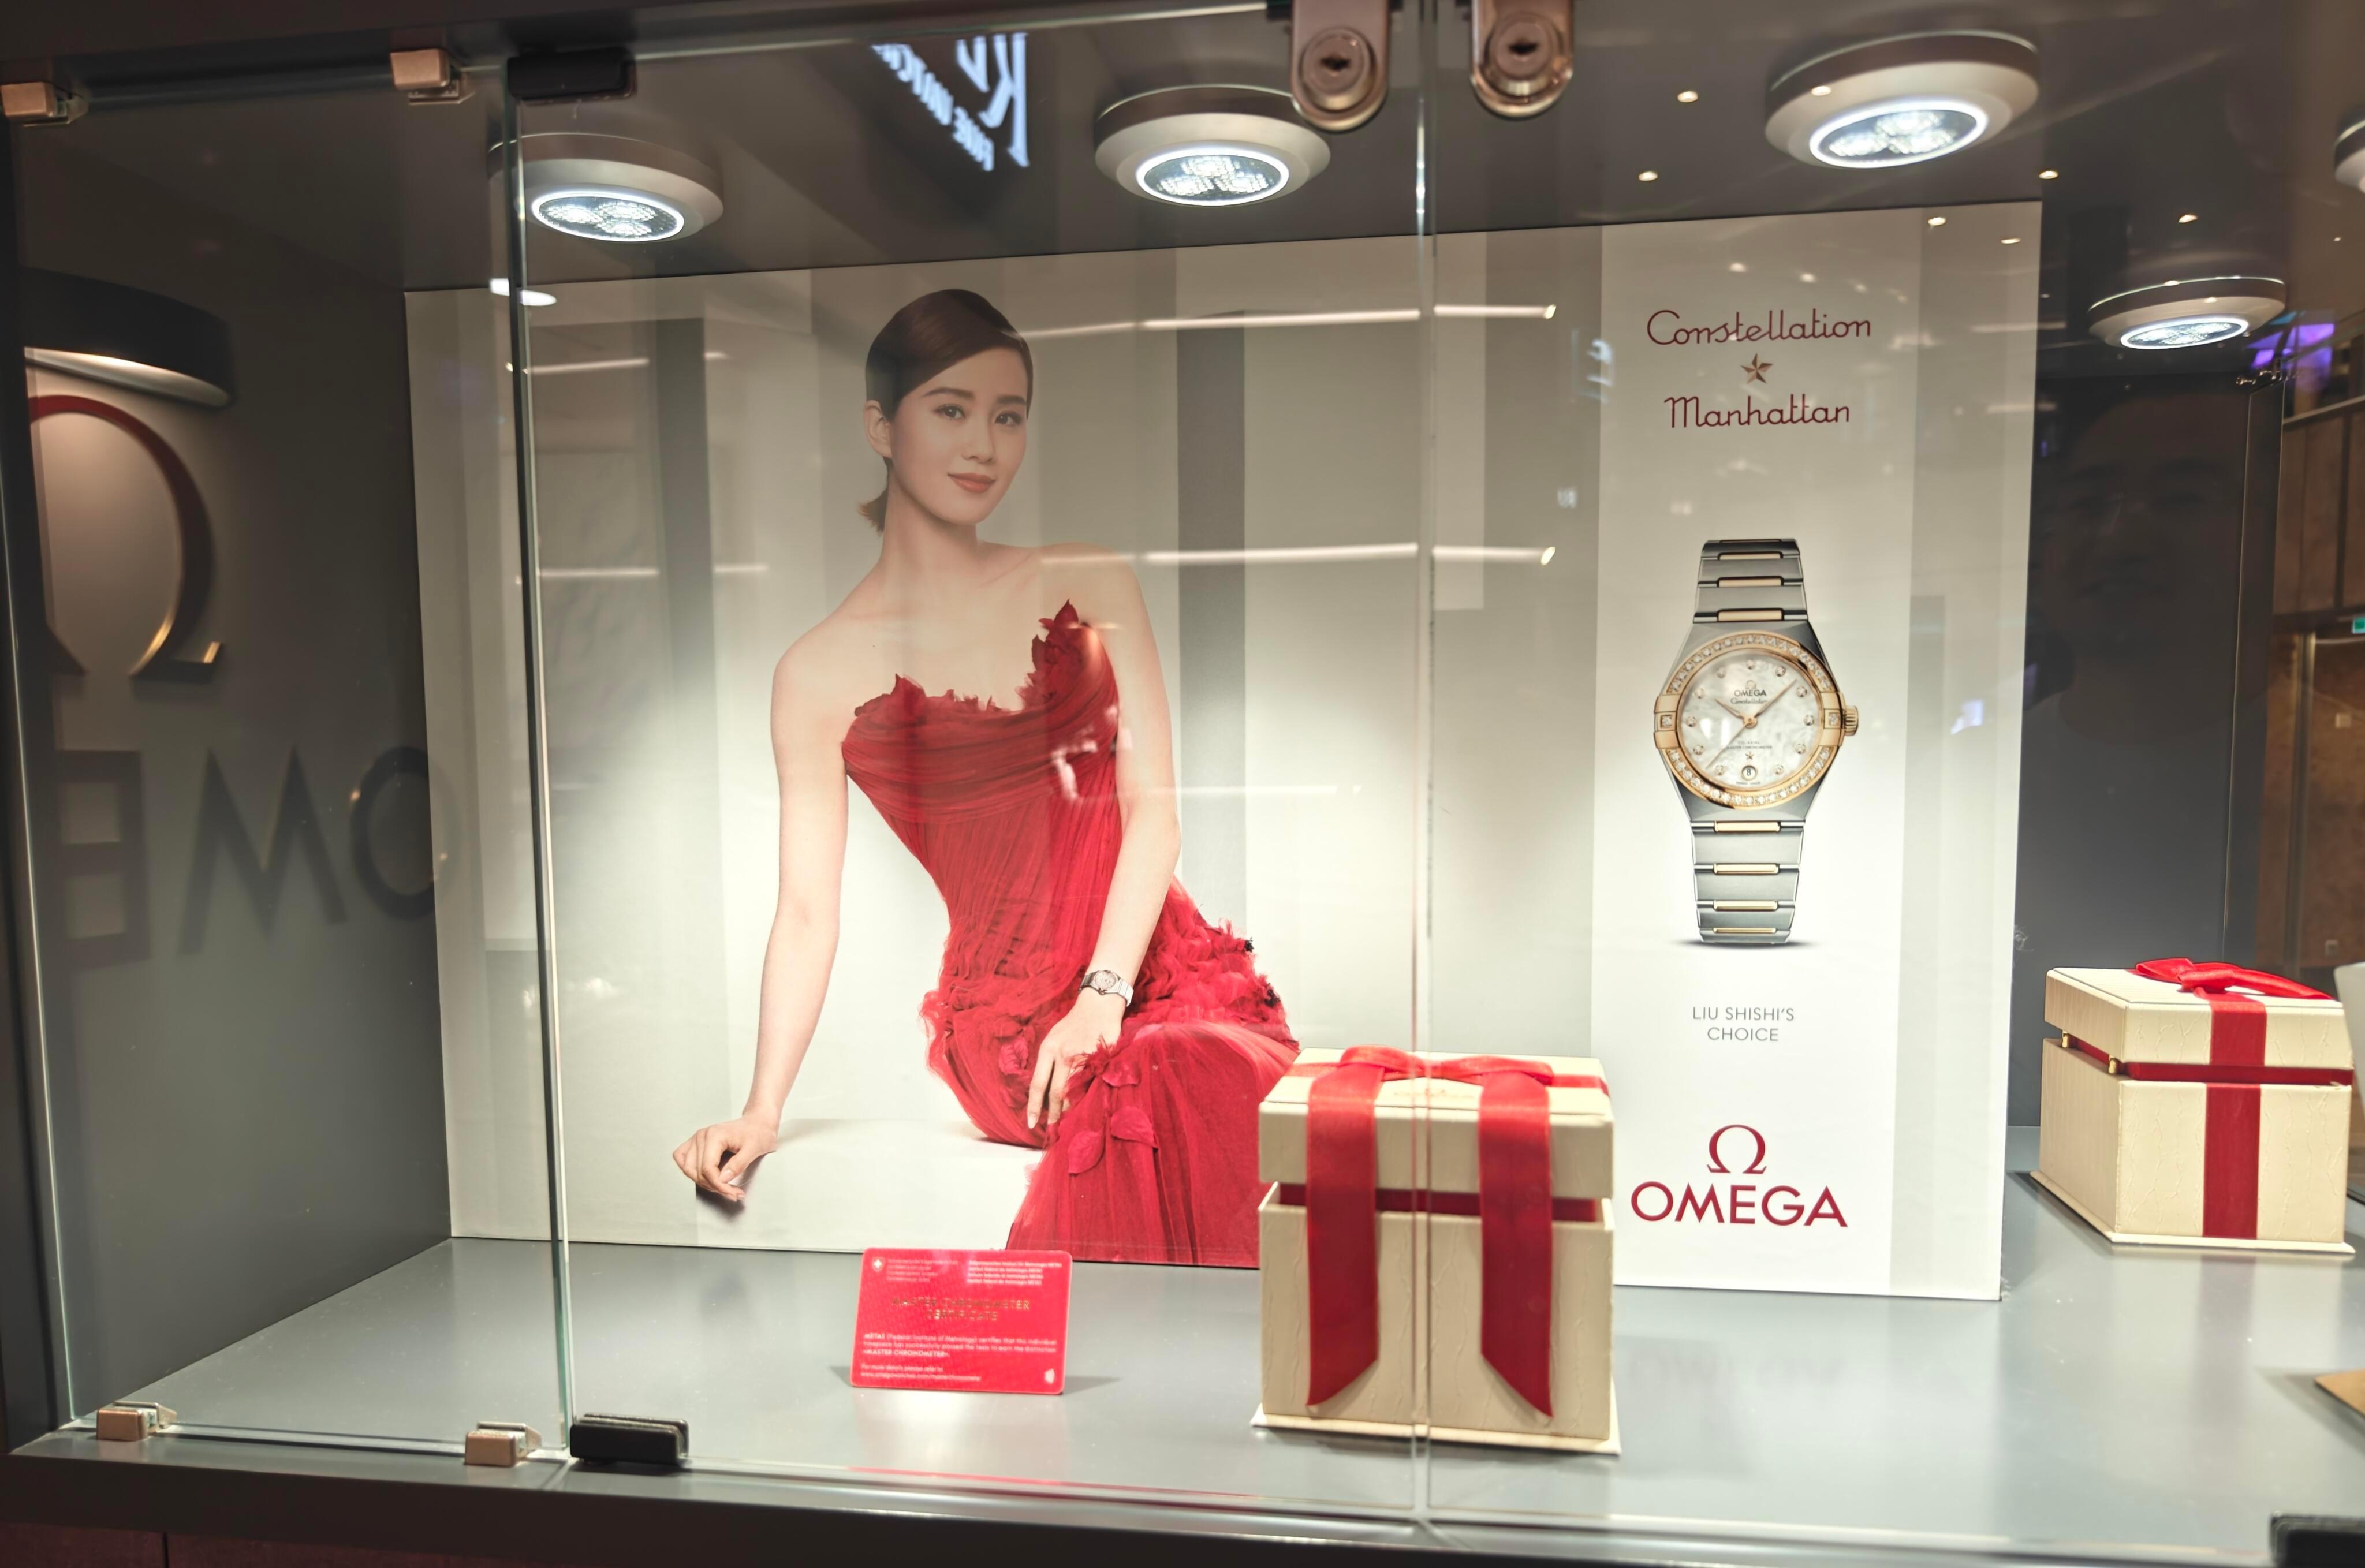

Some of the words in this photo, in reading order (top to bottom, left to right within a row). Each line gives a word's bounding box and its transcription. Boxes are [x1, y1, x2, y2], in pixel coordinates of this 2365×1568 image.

[1647, 308, 1870, 345] Constellation
[1664, 393, 1849, 428] Manhattan
[1746, 768, 1751, 776] 8
[1692, 1006, 1718, 1020] LIU
[1725, 1007, 1795, 1021] SHISHI'S
[1707, 1027, 1778, 1041] CHOICE
[1631, 1181, 1848, 1227] OMEGA
